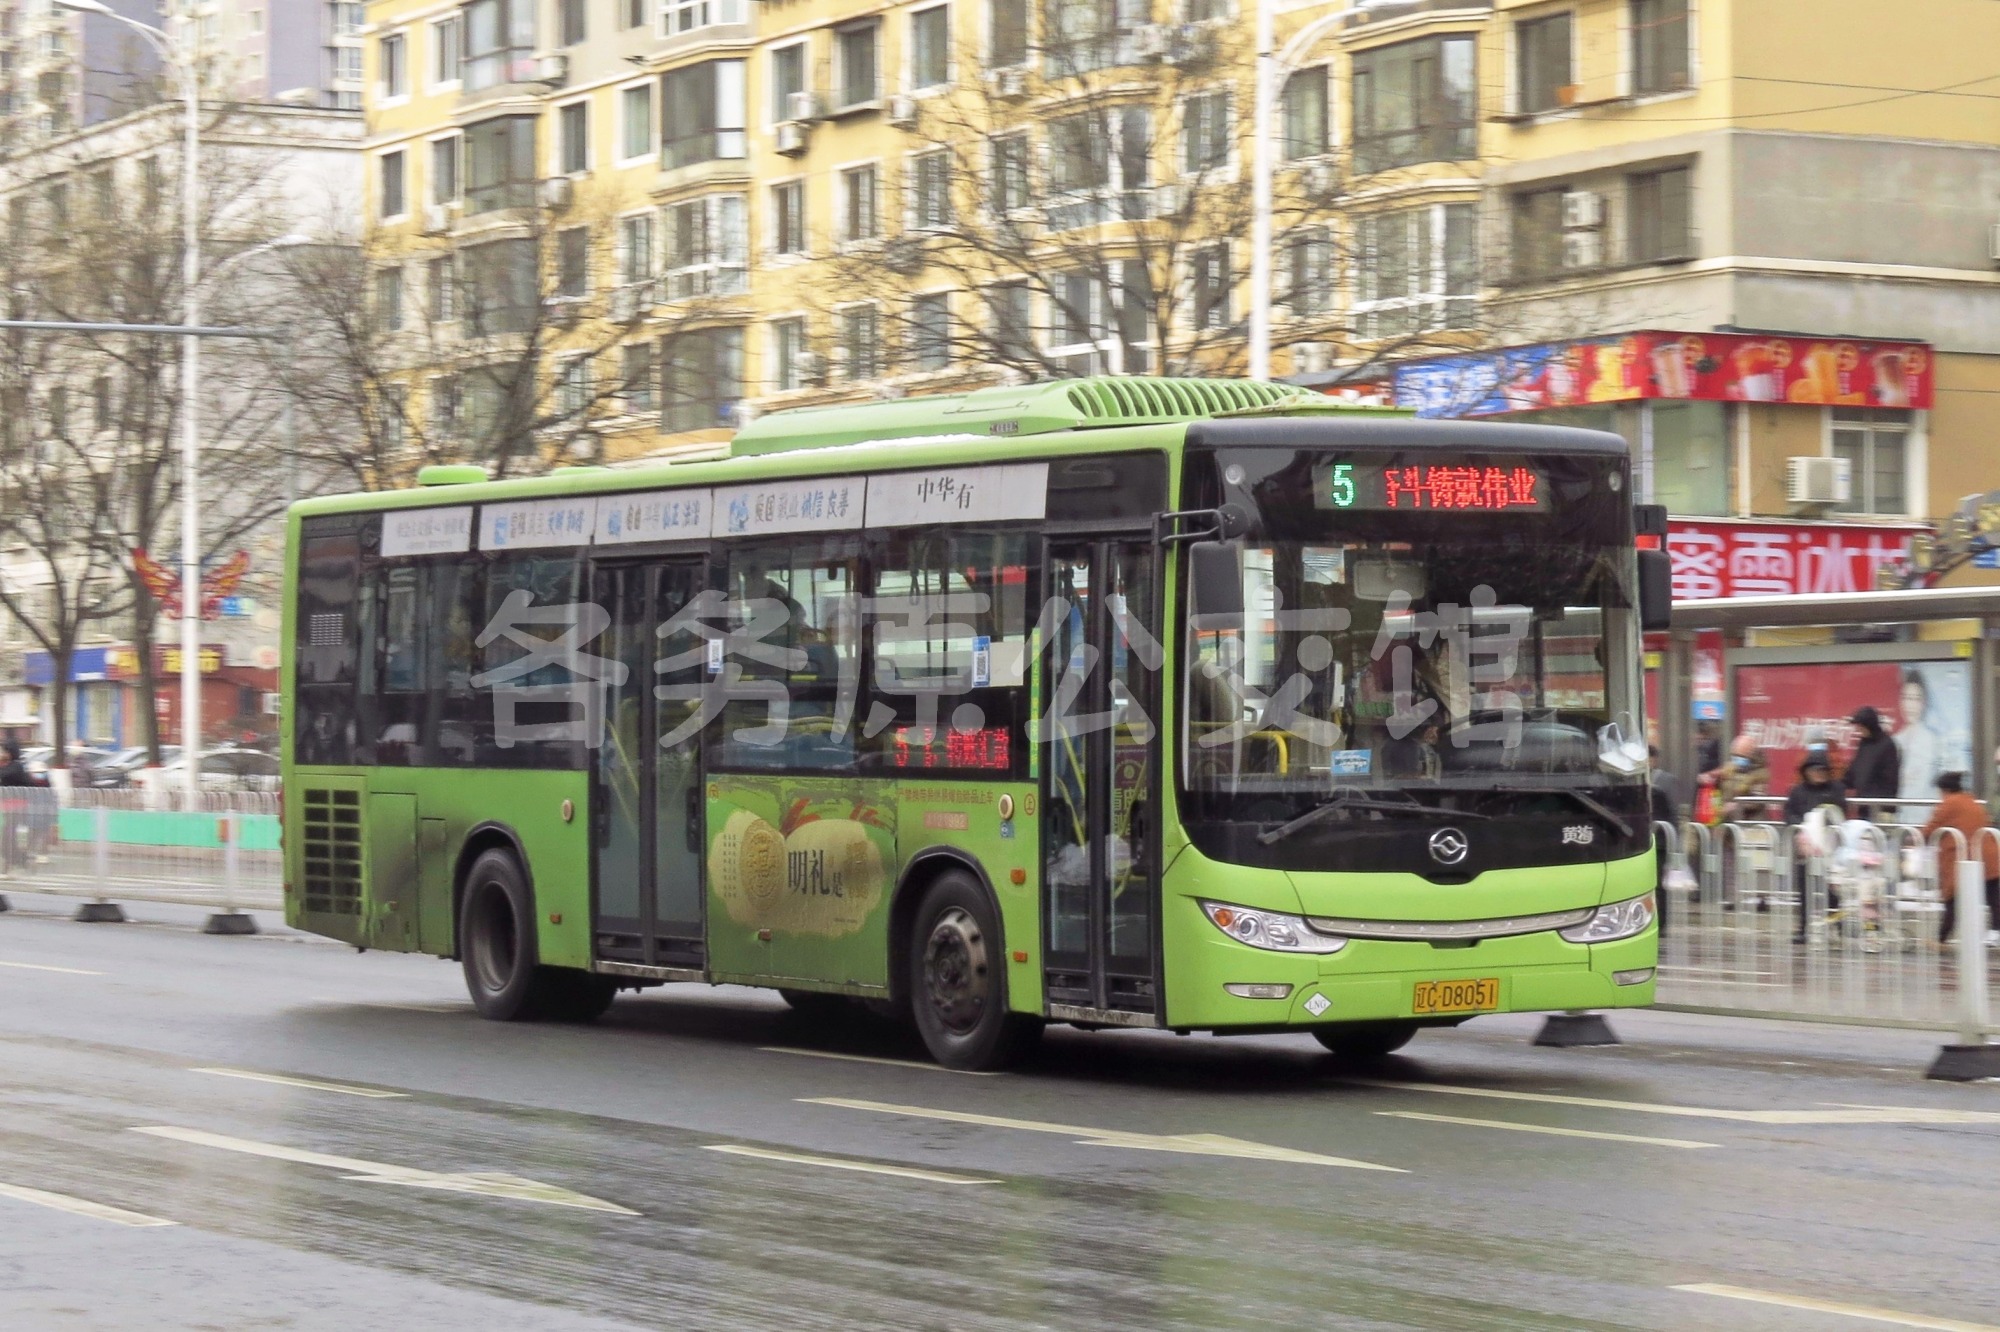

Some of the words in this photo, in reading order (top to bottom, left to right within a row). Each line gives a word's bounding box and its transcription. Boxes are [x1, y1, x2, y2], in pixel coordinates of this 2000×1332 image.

[1332, 464, 1356, 507] 5
[1308, 1000, 1327, 1010] LNG
[1416, 984, 1494, 1008] 辽C·D8051
